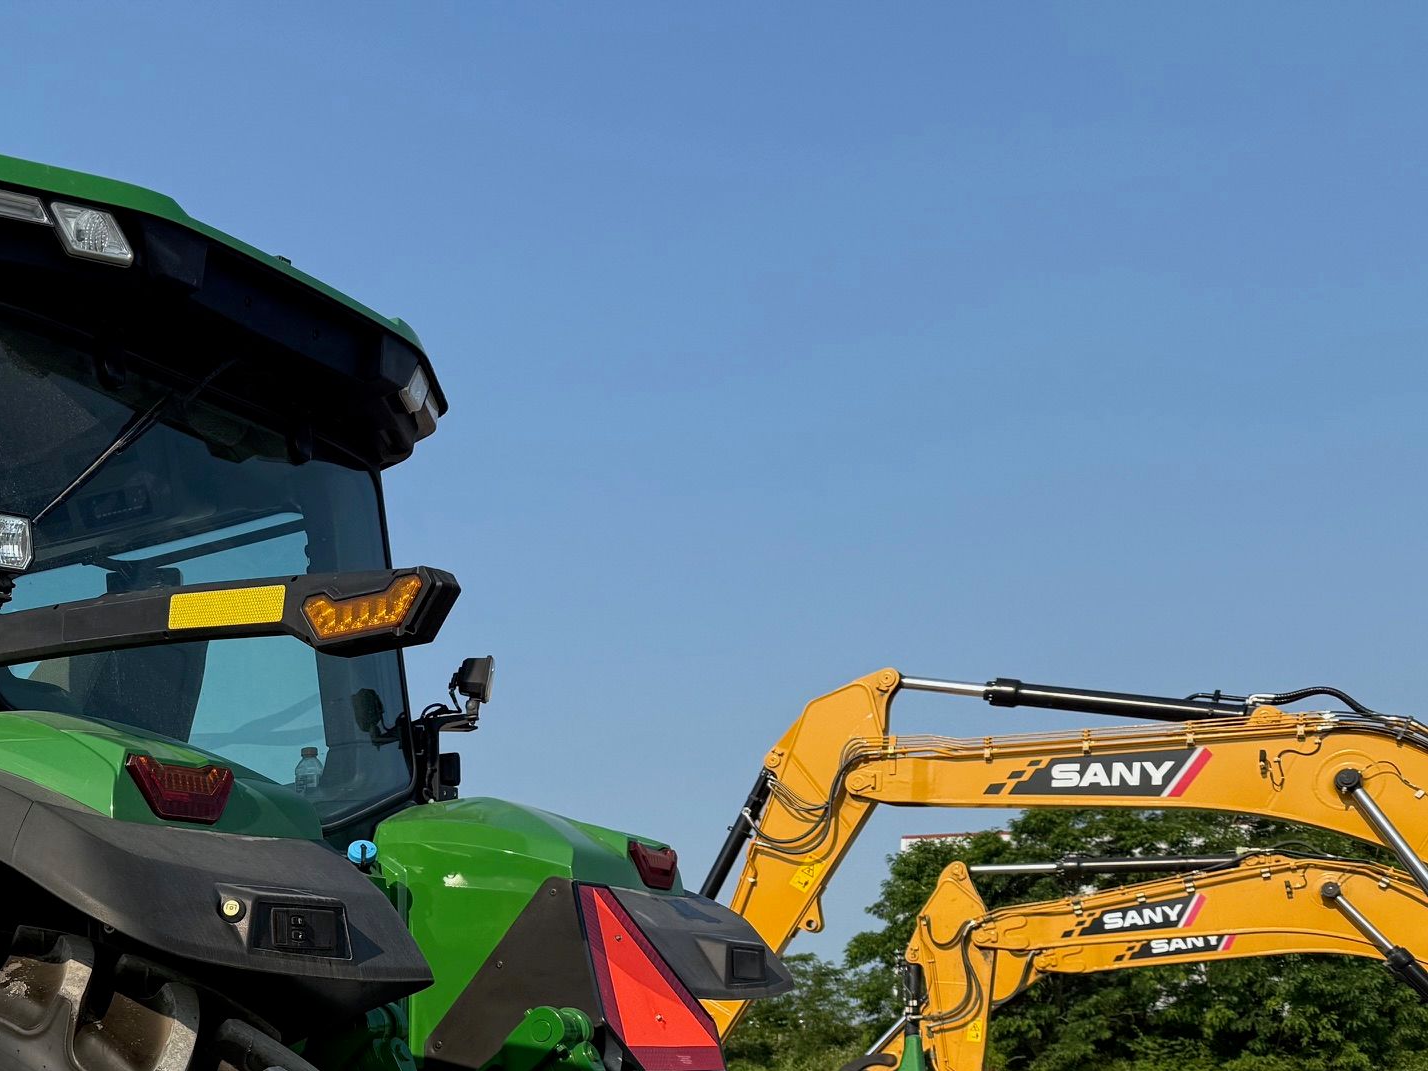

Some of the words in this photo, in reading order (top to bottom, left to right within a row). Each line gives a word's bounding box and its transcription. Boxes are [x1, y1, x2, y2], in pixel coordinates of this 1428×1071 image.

[1051, 761, 1175, 788] SANY
[1102, 904, 1183, 930] SANY
[1150, 936, 1219, 954] SANY
